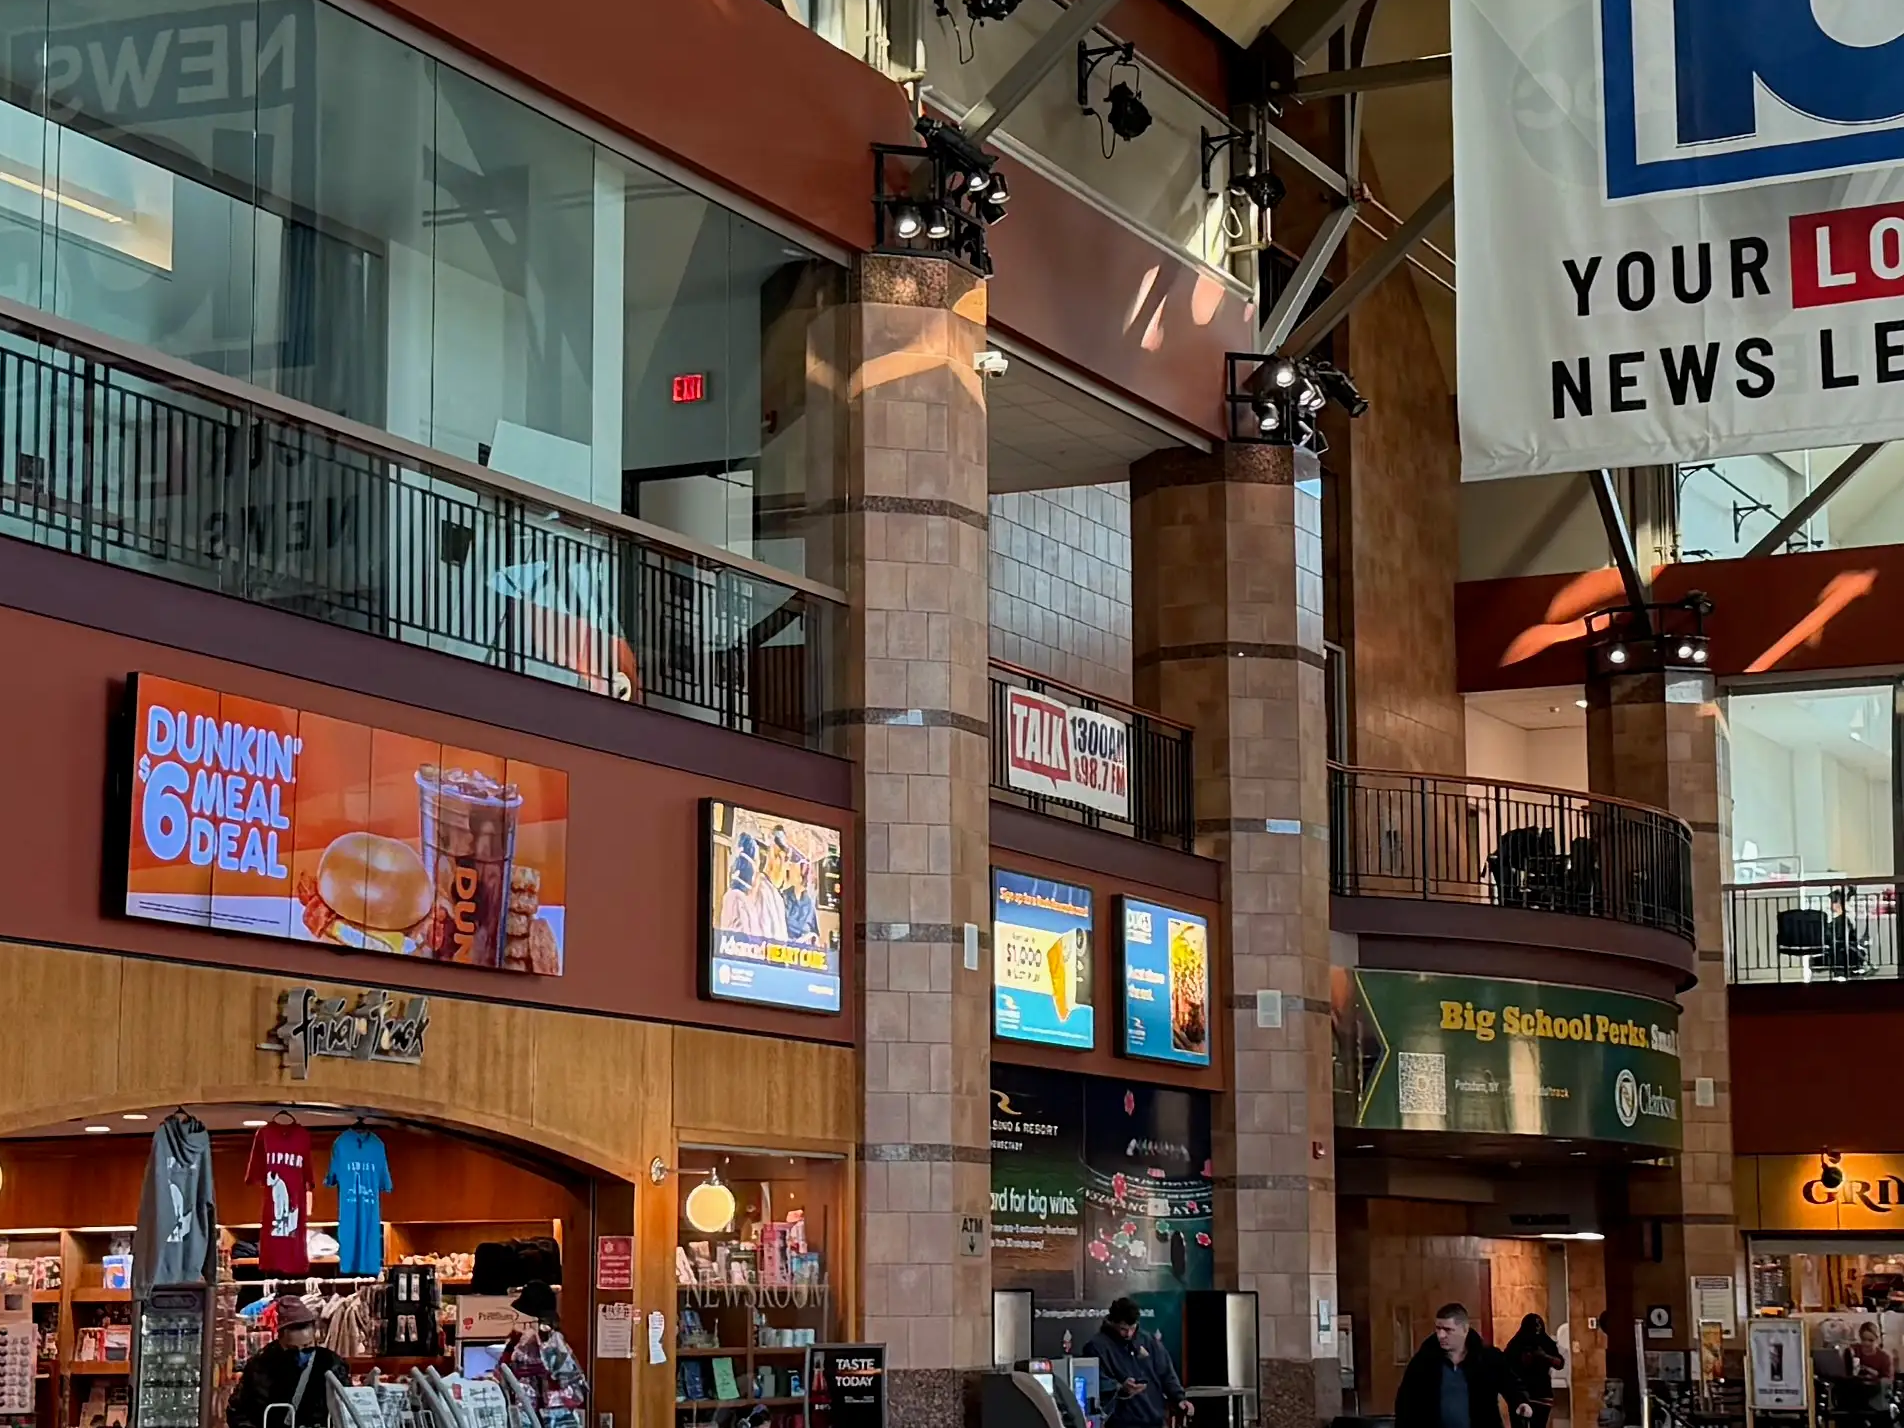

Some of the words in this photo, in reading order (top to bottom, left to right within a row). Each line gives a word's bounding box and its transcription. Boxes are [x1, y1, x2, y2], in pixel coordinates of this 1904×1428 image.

[1563, 235, 1772, 318] YOUR
[673, 374, 704, 404] EXIT
[1550, 338, 1776, 420] NEWS
[1012, 702, 1068, 771] TALK
[1110, 762, 1126, 798] FM
[190, 768, 291, 830] MEAL
[189, 817, 288, 879] DEAL
[1439, 1000, 1496, 1042] Big
[1502, 1005, 1593, 1042] School
[1595, 1014, 1650, 1049] Perks.
[1023, 1123, 1059, 1137] RESORT
[266, 1151, 304, 1168] TIPPER
[1010, 1187, 1027, 1213] for
[1028, 1187, 1048, 1221] big
[961, 1215, 984, 1234] ATM
[684, 1268, 830, 1310] NEWSROOM
[835, 1357, 876, 1371] TASTE
[835, 1375, 874, 1388] TODAY
